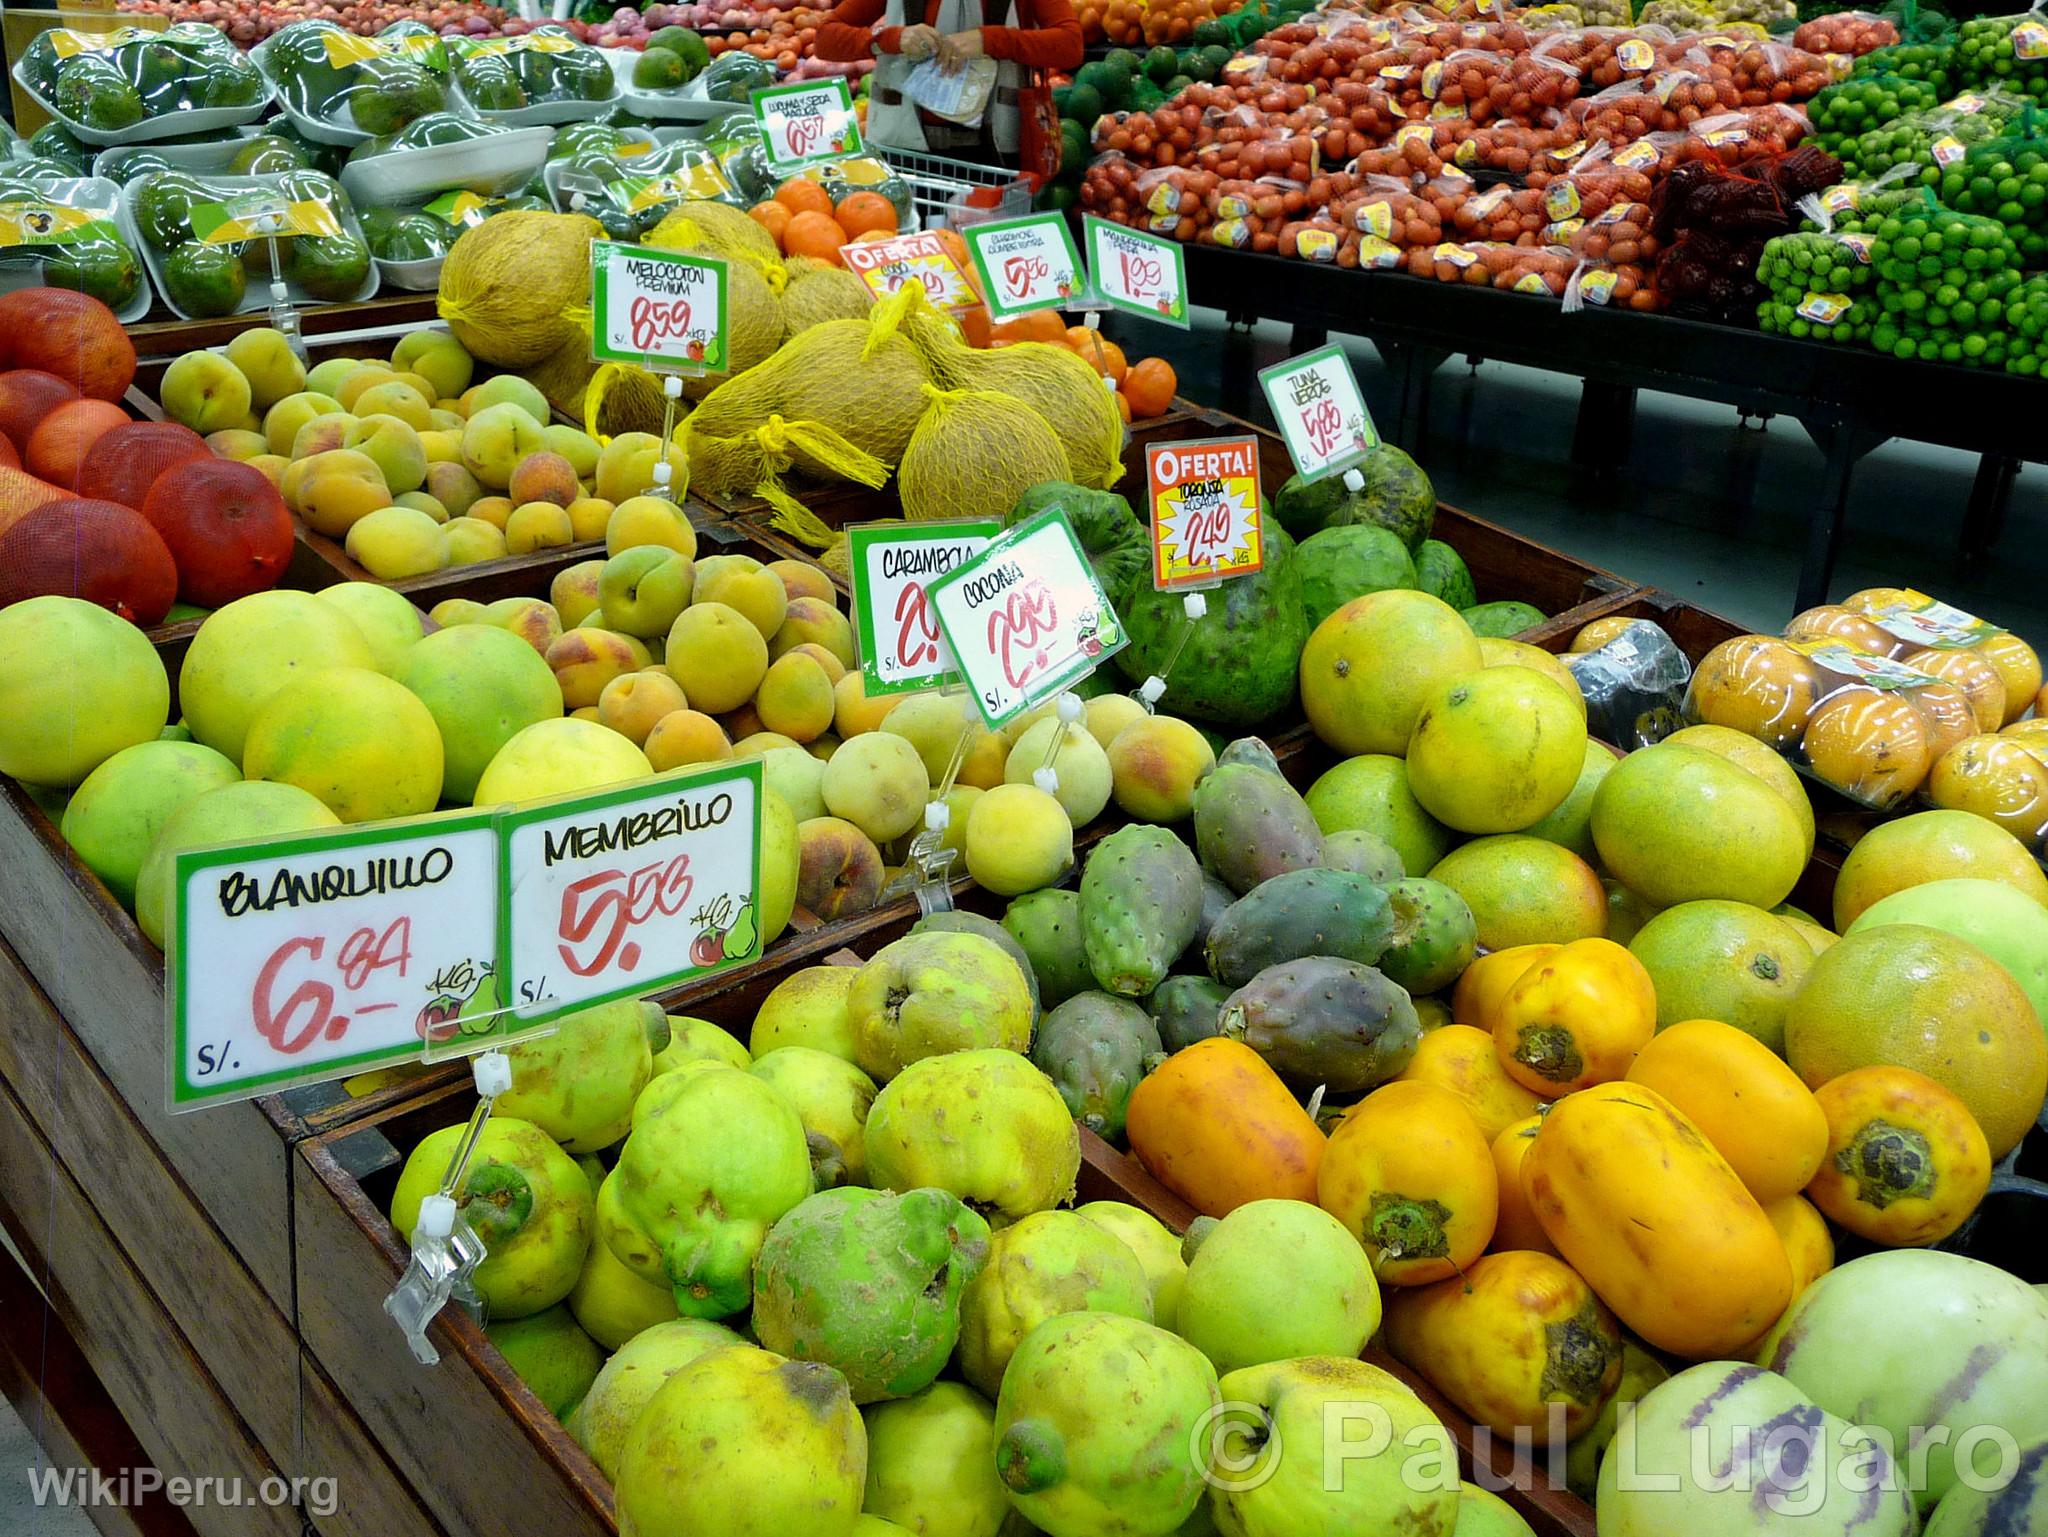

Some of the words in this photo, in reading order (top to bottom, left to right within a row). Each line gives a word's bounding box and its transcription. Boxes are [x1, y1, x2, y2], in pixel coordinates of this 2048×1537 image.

[851, 235, 942, 269] OFERTA!
[626, 259, 705, 284] MELOCOTON
[636, 275, 691, 296] PREMIUM
[1286, 367, 1321, 390] TUNA
[1290, 378, 1332, 407] VERDE
[1155, 445, 1252, 485] OFERTA!
[544, 792, 733, 867] MEMBRILLO
[219, 847, 453, 917] BLANQUILLO
[197, 1040, 241, 1076] S/.
